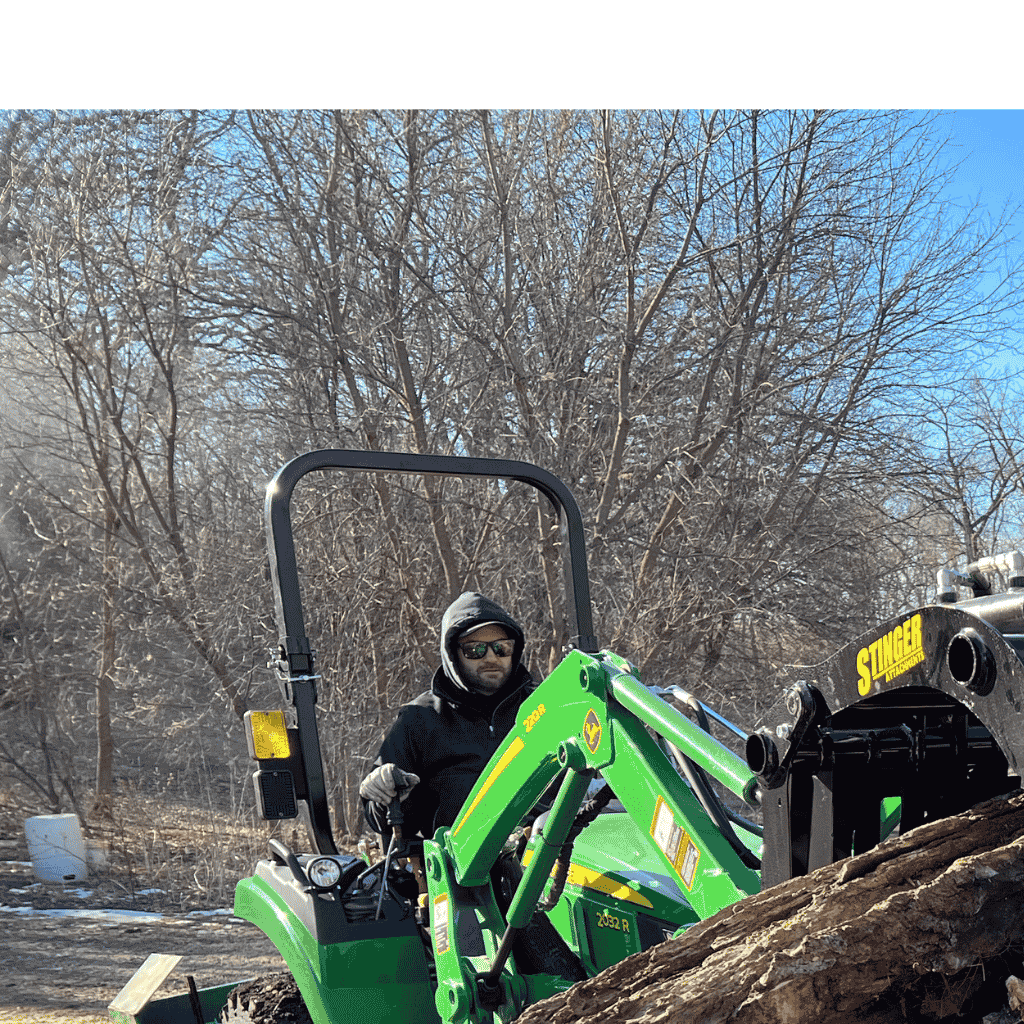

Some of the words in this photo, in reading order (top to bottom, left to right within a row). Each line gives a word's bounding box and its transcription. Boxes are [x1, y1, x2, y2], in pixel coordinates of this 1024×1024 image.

[857, 614, 922, 697] STINGER
[885, 650, 925, 683] ATTACHMENTS
[596, 911, 621, 931] 2032
[621, 918, 631, 933] R
